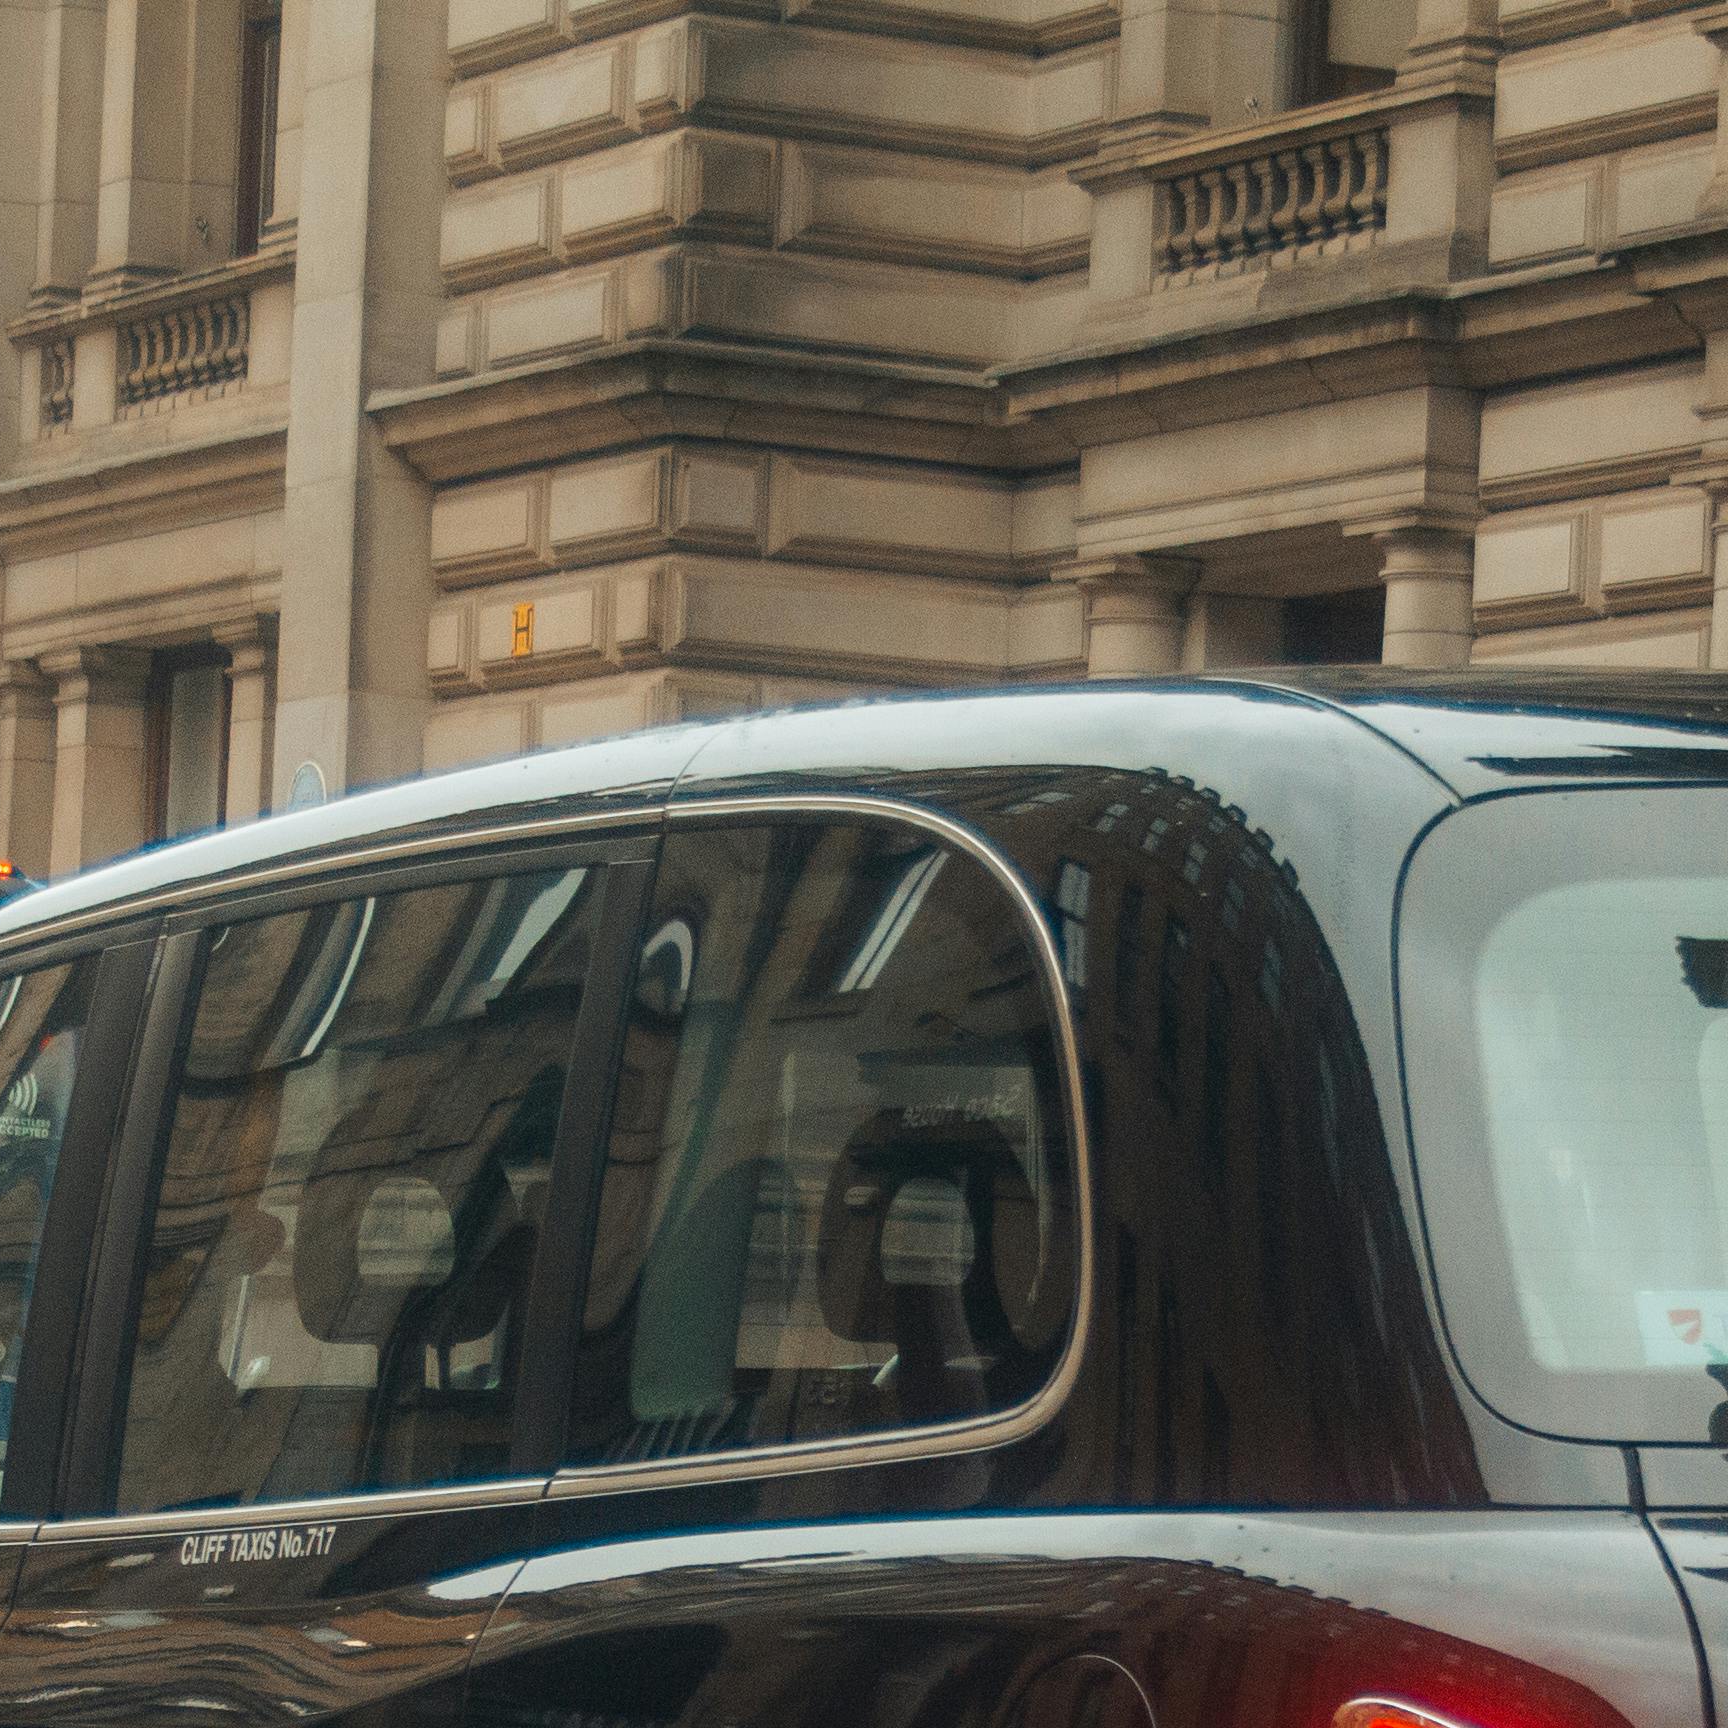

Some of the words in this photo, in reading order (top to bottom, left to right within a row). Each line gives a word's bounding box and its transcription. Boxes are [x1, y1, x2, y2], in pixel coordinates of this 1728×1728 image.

[513, 608, 533, 655] H
[181, 1536, 227, 1566] CLIFF
[229, 1531, 277, 1562] TAXIS
[278, 1526, 336, 1559] No.717
